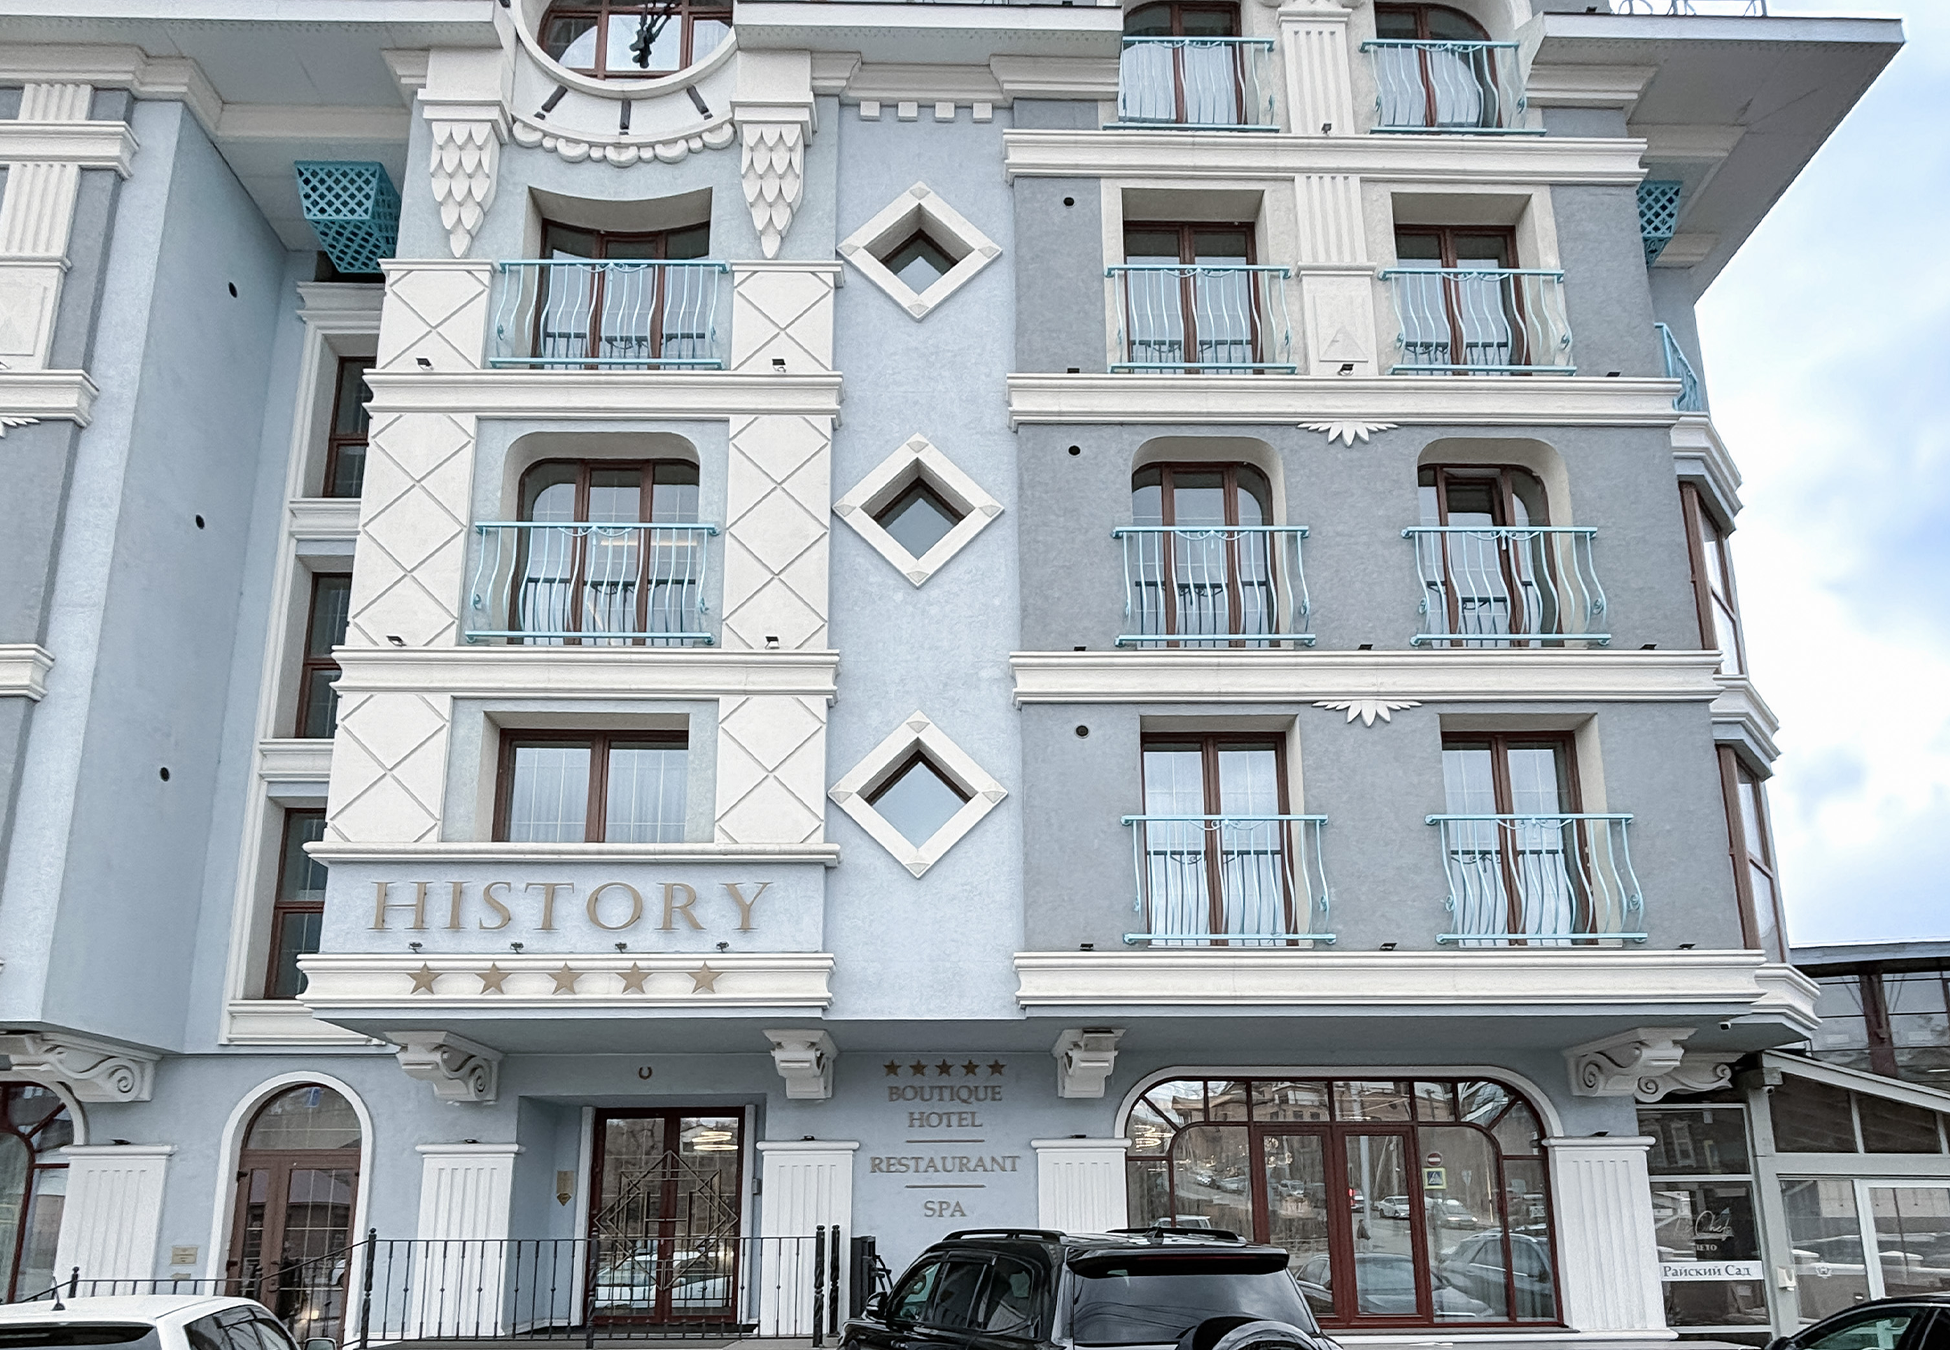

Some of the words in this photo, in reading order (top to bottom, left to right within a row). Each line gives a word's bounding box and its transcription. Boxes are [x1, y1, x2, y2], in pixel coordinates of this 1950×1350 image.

[367, 880, 774, 931] HISTORY
[887, 1085, 1003, 1104] BOUTIQUE
[907, 1111, 984, 1128] HOTEL
[869, 1155, 1021, 1174] RESTAURANT
[923, 1200, 967, 1218] SPA
[1663, 1265, 1722, 1277] Райский
[1725, 1264, 1752, 1277] Сад
